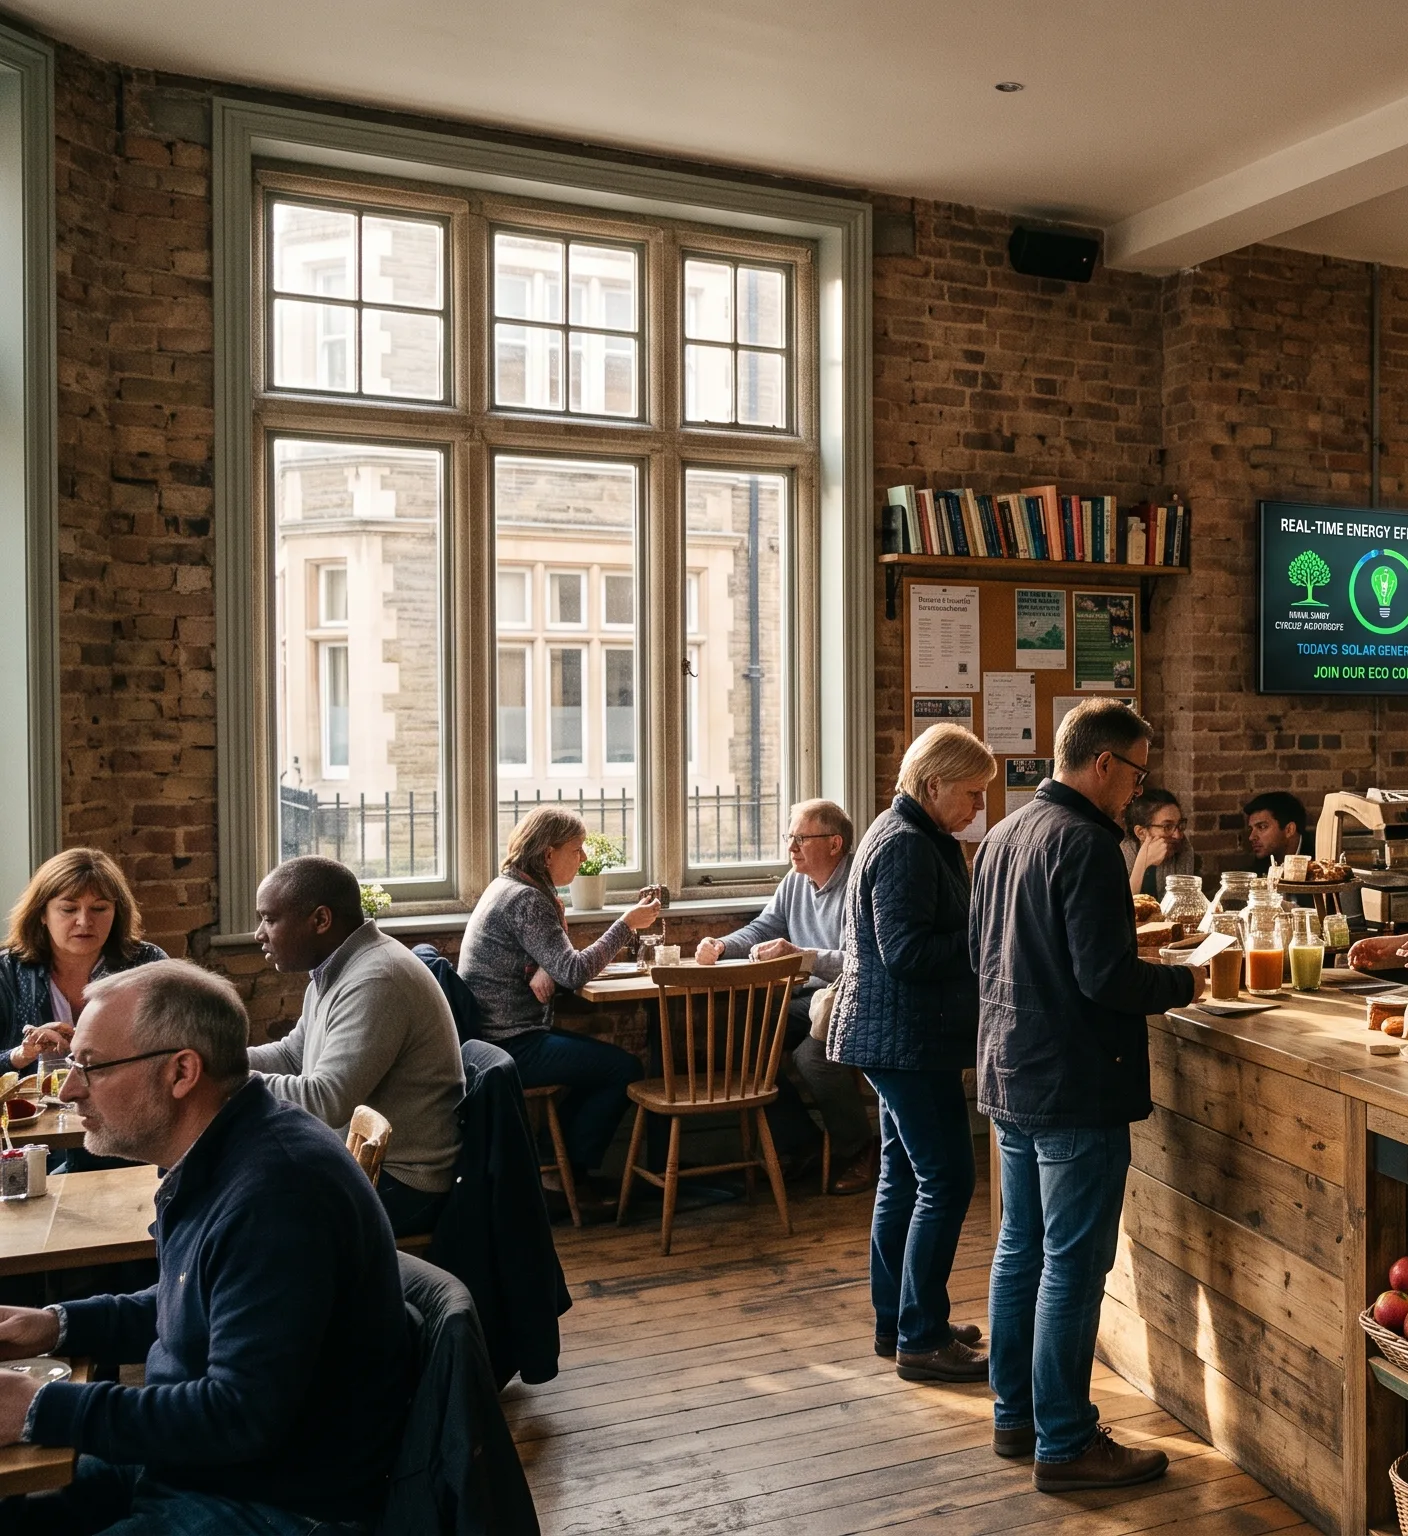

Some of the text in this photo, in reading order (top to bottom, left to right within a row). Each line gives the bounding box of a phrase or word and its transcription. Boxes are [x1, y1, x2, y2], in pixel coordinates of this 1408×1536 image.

[1280, 518, 1344, 537] REAL-TIME
[1346, 522, 1391, 540] ENERGY
[1341, 644, 1376, 656] SOLAR
[1314, 666, 1340, 679] JOIN
[1342, 666, 1365, 679] OUR
[1368, 667, 1389, 679] ECO
